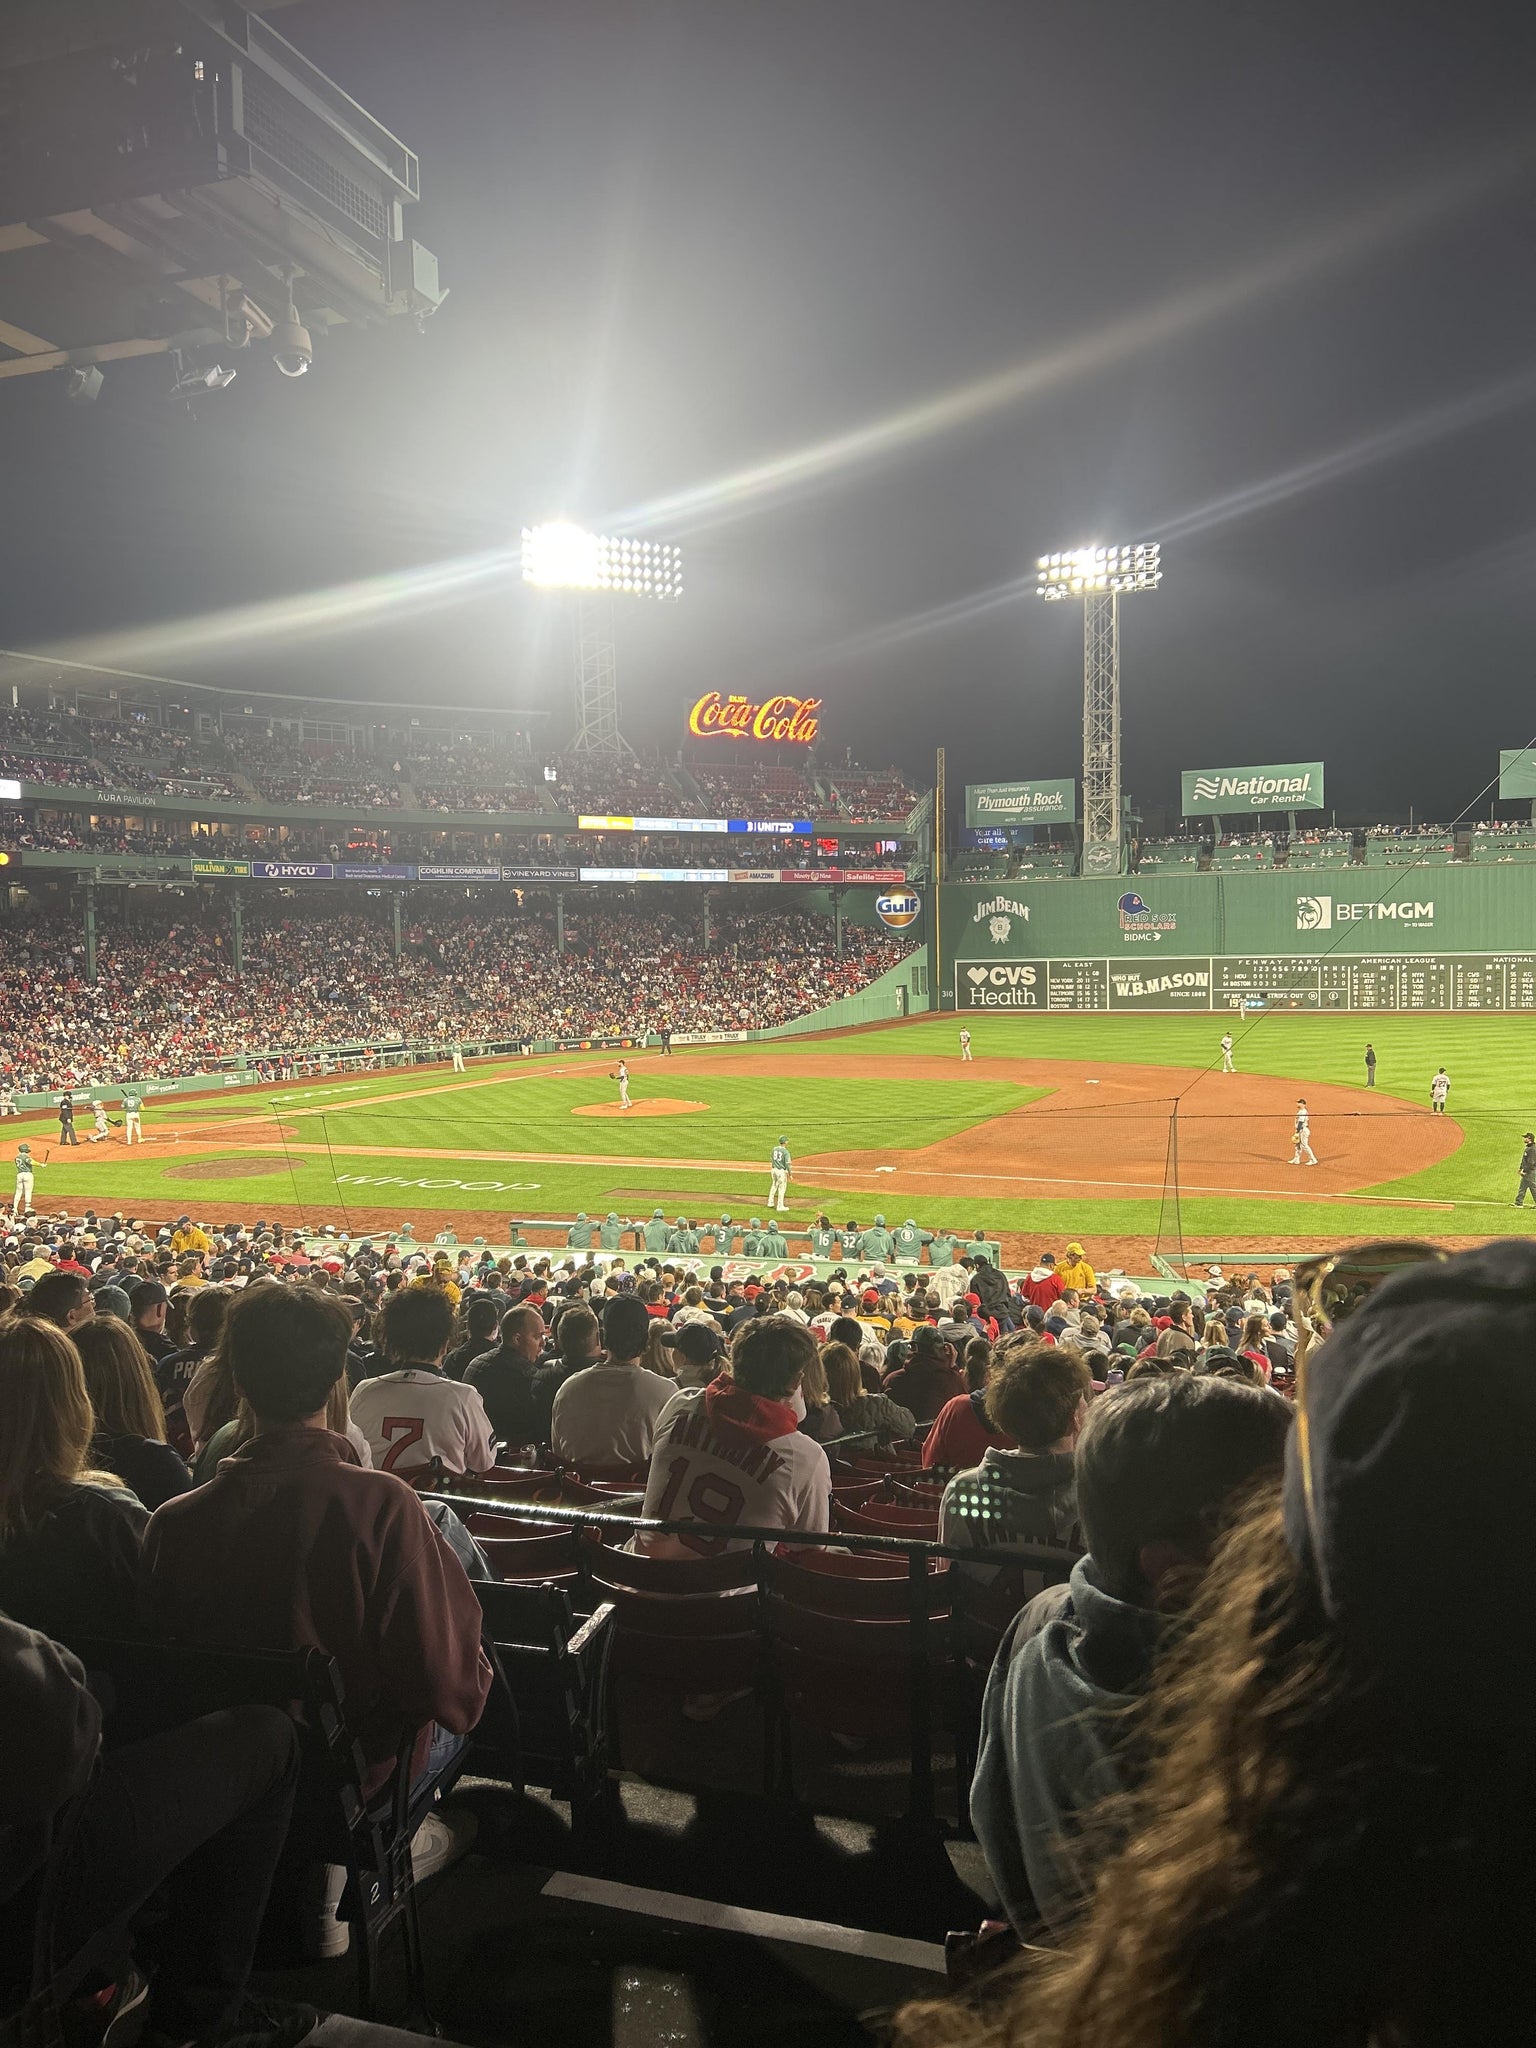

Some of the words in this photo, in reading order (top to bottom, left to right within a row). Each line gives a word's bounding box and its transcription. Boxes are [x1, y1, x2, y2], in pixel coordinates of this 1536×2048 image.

[1220, 774, 1310, 796] National
[124, 796, 156, 805] PAVILION
[977, 794, 1030, 810] Plymouth
[1033, 792, 1064, 806] Rock
[1251, 796, 1269, 804] Car
[1272, 794, 1305, 803] Rental
[194, 863, 224, 872] SULLIVAN
[234, 866, 248, 874] TIRE
[282, 866, 316, 876] HYCU
[878, 898, 918, 913] Gulf
[973, 901, 995, 922] JIM
[996, 896, 1030, 921] BEAM
[1336, 902, 1434, 920] BETMGM
[1125, 914, 1148, 922] RED
[1152, 914, 1176, 922] SOX
[1124, 922, 1176, 930] SCHOLARS
[1124, 933, 1151, 941] BIDMC
[990, 966, 1036, 986] CVS
[1110, 974, 1126, 982] WHO
[942, 990, 953, 998] 310
[970, 987, 1037, 1005] Health
[160, 1084, 179, 1093] TICKET
[332, 1174, 542, 1192] WHOOP
[718, 1231, 726, 1242] 3
[819, 1233, 829, 1247] 16
[843, 1235, 856, 1249] 32
[382, 1417, 424, 1471] 7
[370, 1881, 381, 1904] 2
